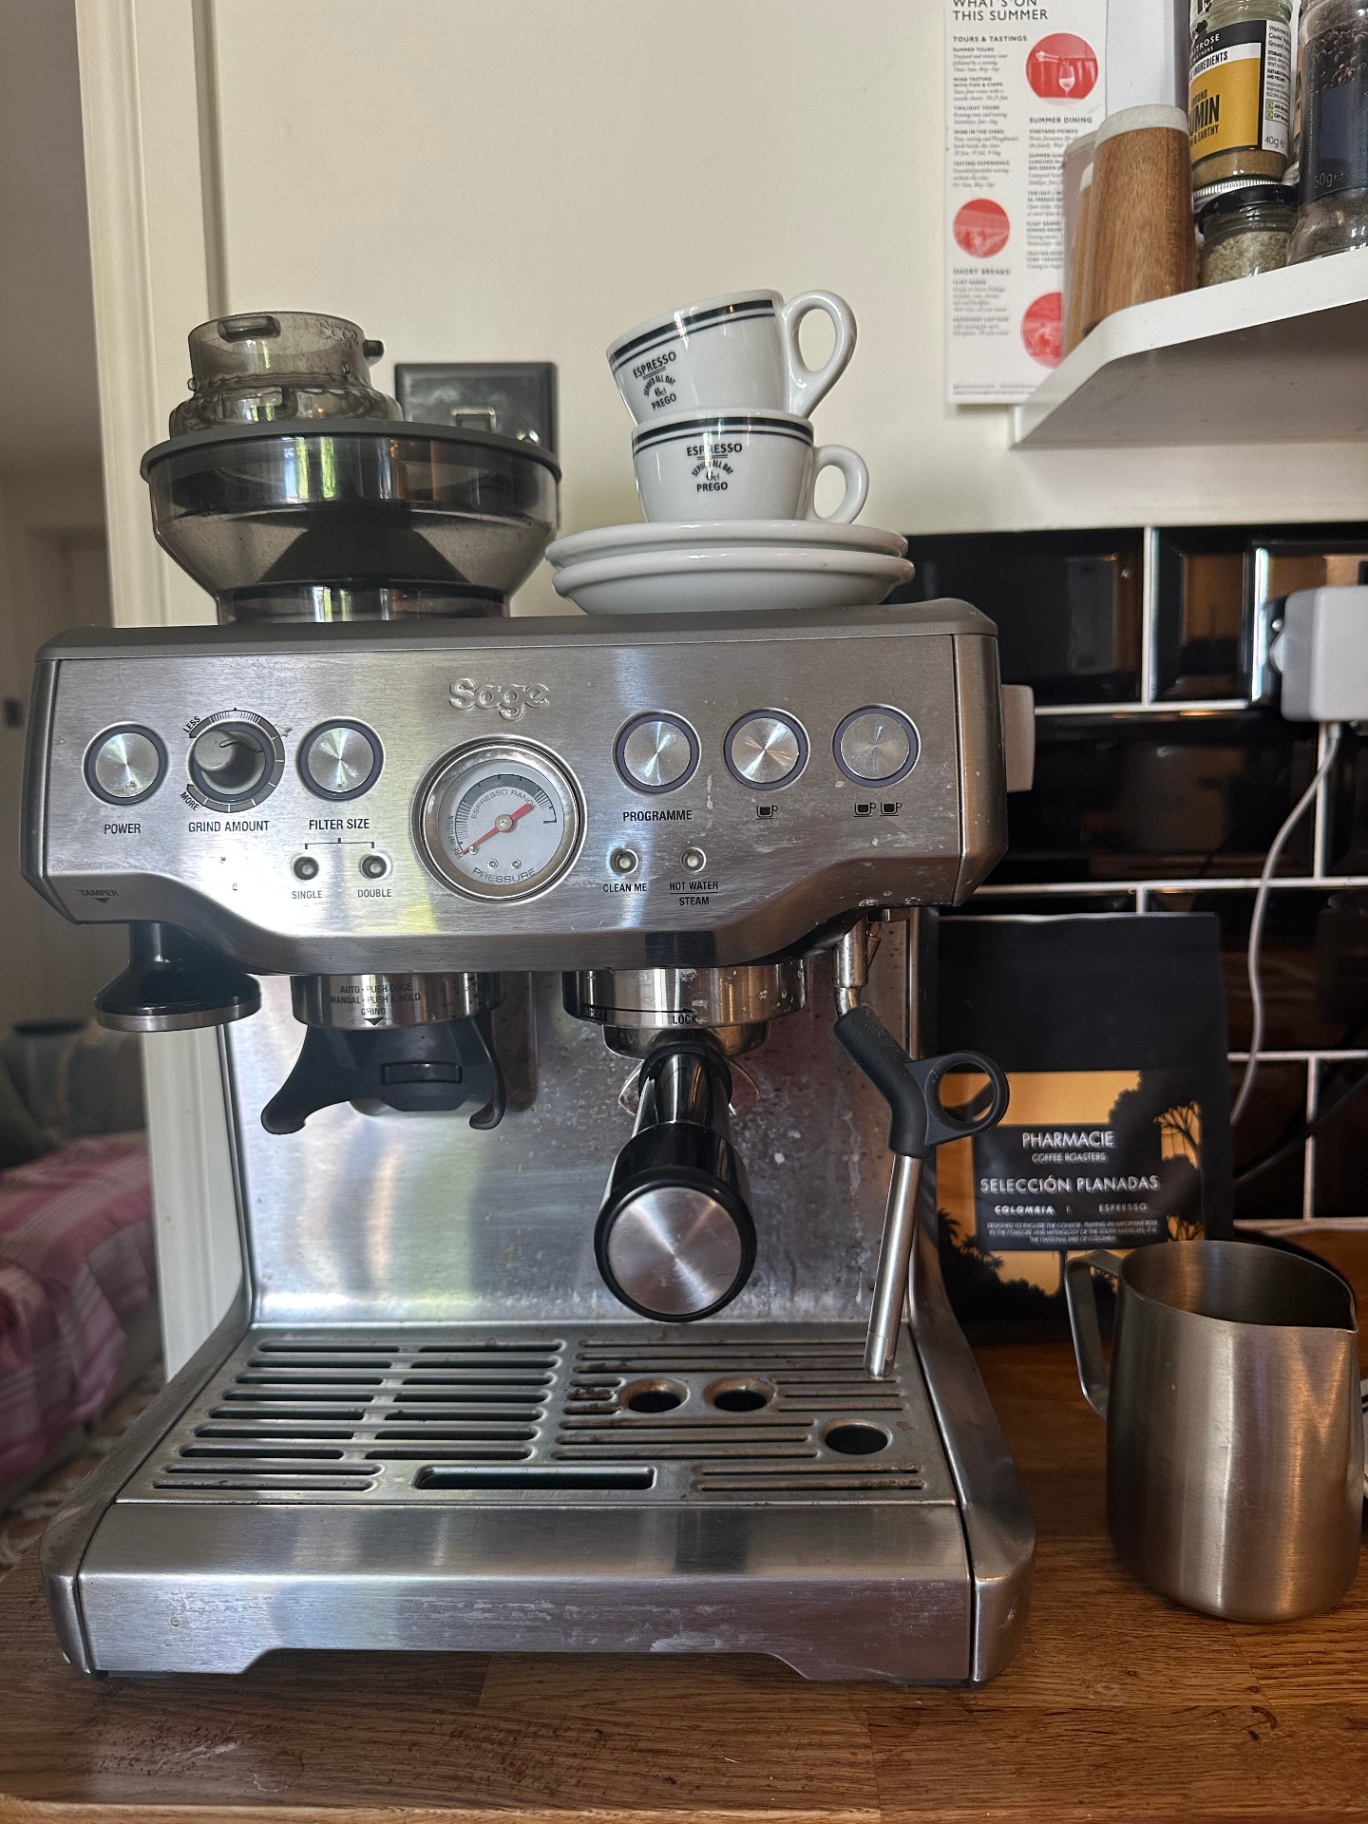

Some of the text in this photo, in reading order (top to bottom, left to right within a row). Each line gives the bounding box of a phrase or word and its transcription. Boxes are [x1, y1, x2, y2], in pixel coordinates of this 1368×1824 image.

[952, 0, 1007, 8] WHATS
[952, 9, 1049, 21] THIS SUMMER
[1189, 93, 1221, 138] UMIN
[1313, 172, 1333, 189] 50g
[632, 351, 677, 379] ESPRESSO
[651, 393, 677, 411] PREGO
[696, 481, 728, 493] PREGO
[448, 677, 550, 722] Sage
[182, 715, 201, 734] LESS
[179, 791, 200, 812] MORE
[470, 789, 508, 820] ESPRESSO
[622, 809, 693, 822] PROGRAMME
[104, 823, 142, 835] POWER
[188, 820, 271, 833] GRIND AMOUNT
[308, 818, 371, 831] FILTER SIZE
[472, 867, 535, 884] PRESSURE
[602, 883, 648, 893] CLEAN ME
[669, 880, 719, 891] HOT WATER
[78, 889, 120, 897] TAMPER
[291, 889, 392, 900] SINGLE DOUBLE
[678, 896, 710, 906] STEAM
[340, 982, 413, 994] AUTO PUSH ONCE
[329, 996, 362, 1005] MANUAL
[367, 995, 389, 1004] PUSH
[400, 993, 421, 1002] HOLD
[361, 1007, 387, 1016] GRIND
[672, 1014, 698, 1025] LOCK
[1021, 1130, 1117, 1150] PHARMACIE
[1031, 1151, 1109, 1164] COFFEE ROASTERS
[979, 1174, 1162, 1195] SELECCIÓN PLANADAS
[994, 1202, 1150, 1216] COLOMBIA ESPRESSO
